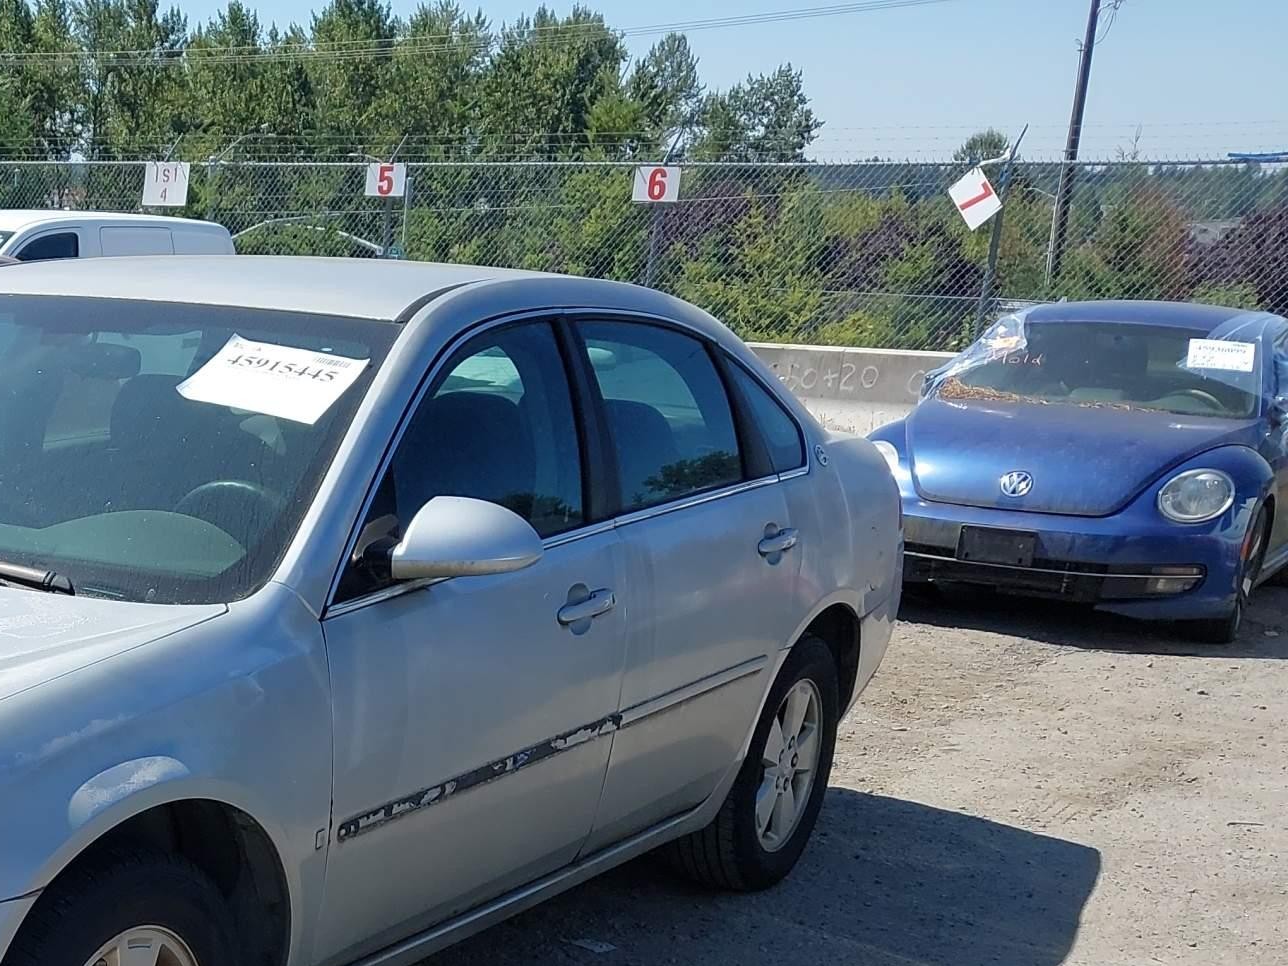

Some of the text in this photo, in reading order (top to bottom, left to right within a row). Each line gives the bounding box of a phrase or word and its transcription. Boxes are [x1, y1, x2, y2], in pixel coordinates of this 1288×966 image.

[159, 186, 168, 202] 4
[377, 165, 394, 195] 5
[647, 167, 668, 201] 6
[958, 180, 994, 211] 7
[226, 353, 340, 383] 45915445
